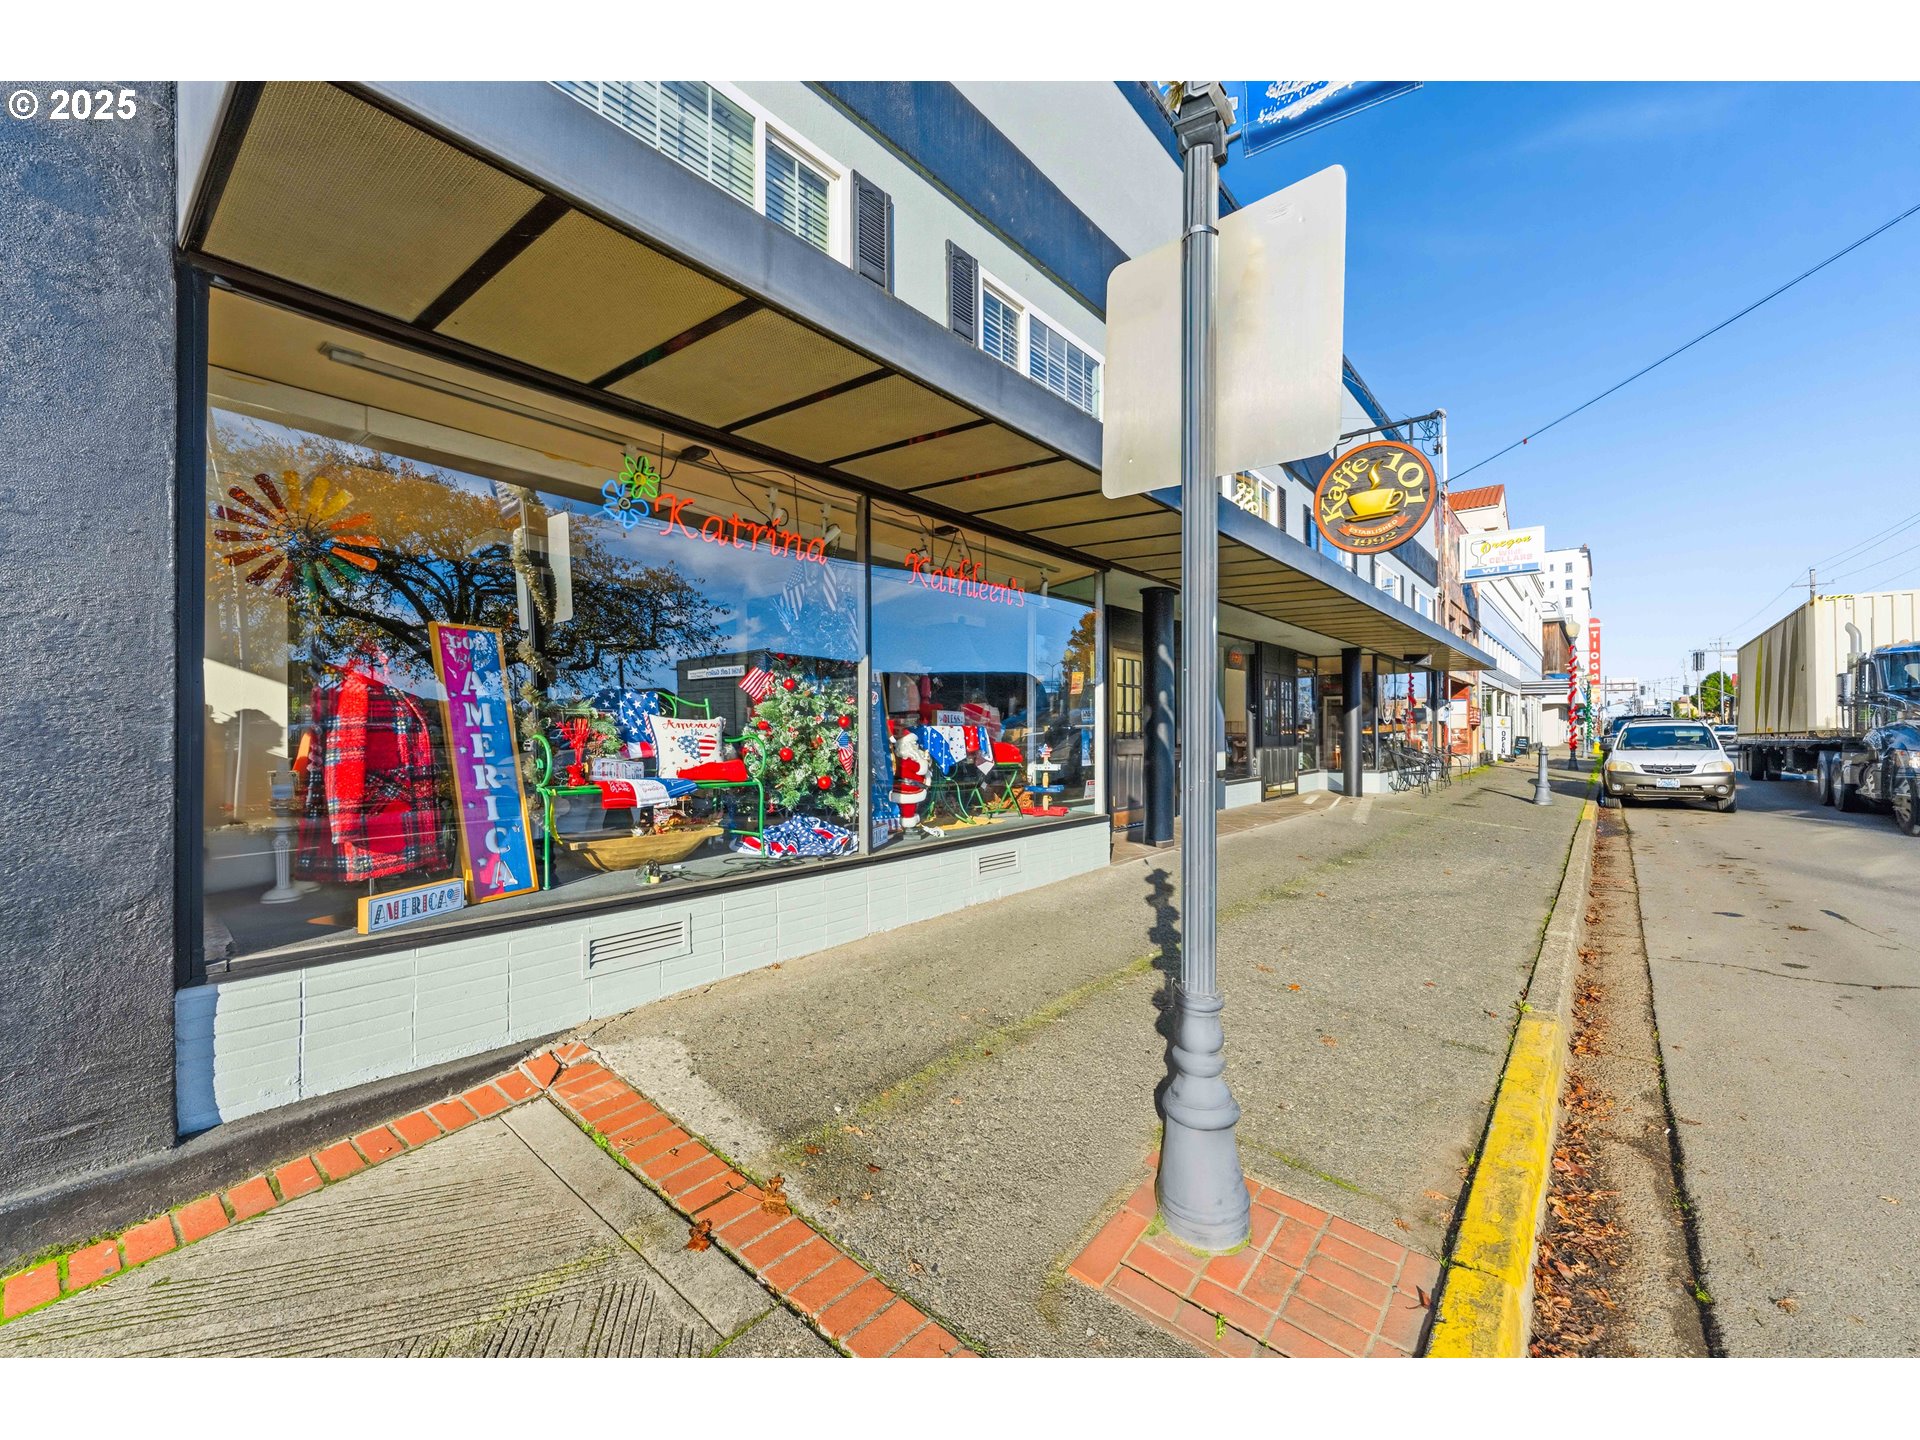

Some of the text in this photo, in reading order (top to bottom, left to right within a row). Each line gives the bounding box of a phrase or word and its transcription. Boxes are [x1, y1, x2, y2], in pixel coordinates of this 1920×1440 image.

[1320, 451, 1426, 526] Kaffe 101
[654, 492, 829, 566] Katrina
[1349, 519, 1398, 535] ESTABLISHED
[1352, 531, 1398, 547] 1992
[1480, 535, 1532, 555] Oregon
[1489, 553, 1533, 564] CELLARS
[905, 552, 1026, 608] Kathleen's
[461, 670, 518, 889] AMERICA
[372, 890, 449, 925] AMERICA
